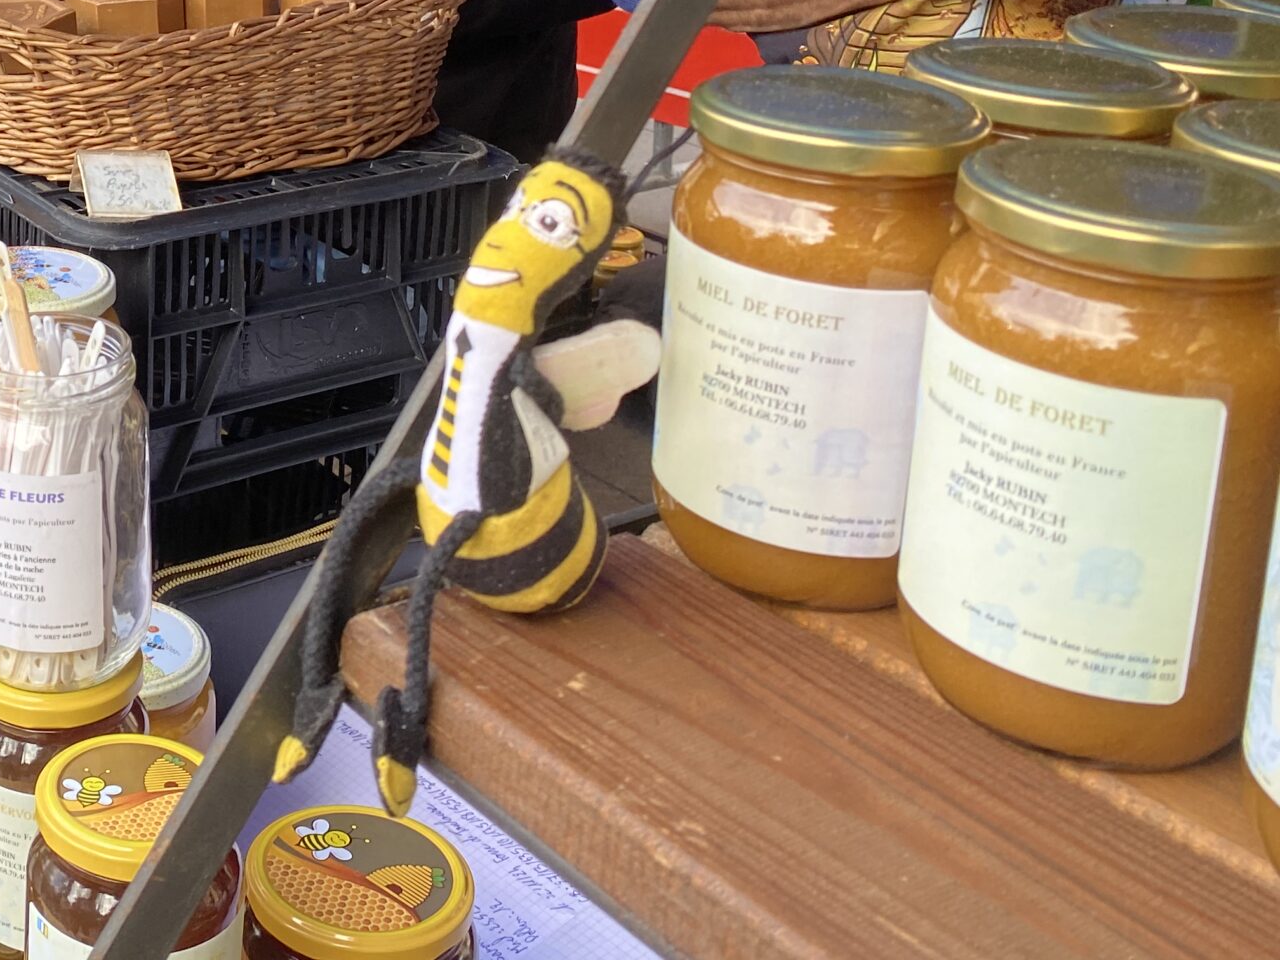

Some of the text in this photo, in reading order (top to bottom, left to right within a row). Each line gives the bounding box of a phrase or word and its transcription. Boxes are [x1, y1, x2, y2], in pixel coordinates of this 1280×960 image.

[697, 277, 844, 331] MIEL DE FORET
[710, 340, 728, 353] par
[718, 326, 737, 341] mis
[740, 337, 755, 348] en
[758, 341, 786, 356] pots
[789, 349, 805, 361] en
[810, 351, 856, 367] France
[715, 364, 790, 396] Jacky RUBIN
[733, 387, 806, 416] MONTECH
[948, 361, 1114, 436] MIEL DE FORET
[960, 432, 978, 449] par
[967, 418, 988, 437] mis
[991, 432, 1007, 446] en
[1011, 440, 1042, 458] pots
[1047, 451, 1066, 466] en
[1072, 455, 1128, 479] France
[10, 490, 65, 504] FLEURS
[964, 461, 1048, 505] Jacky RUBIN
[982, 487, 1066, 529] MONTECH
[4, 540, 32, 553] RUBIN
[4, 562, 13, 570] de
[23, 565, 44, 574] ruche
